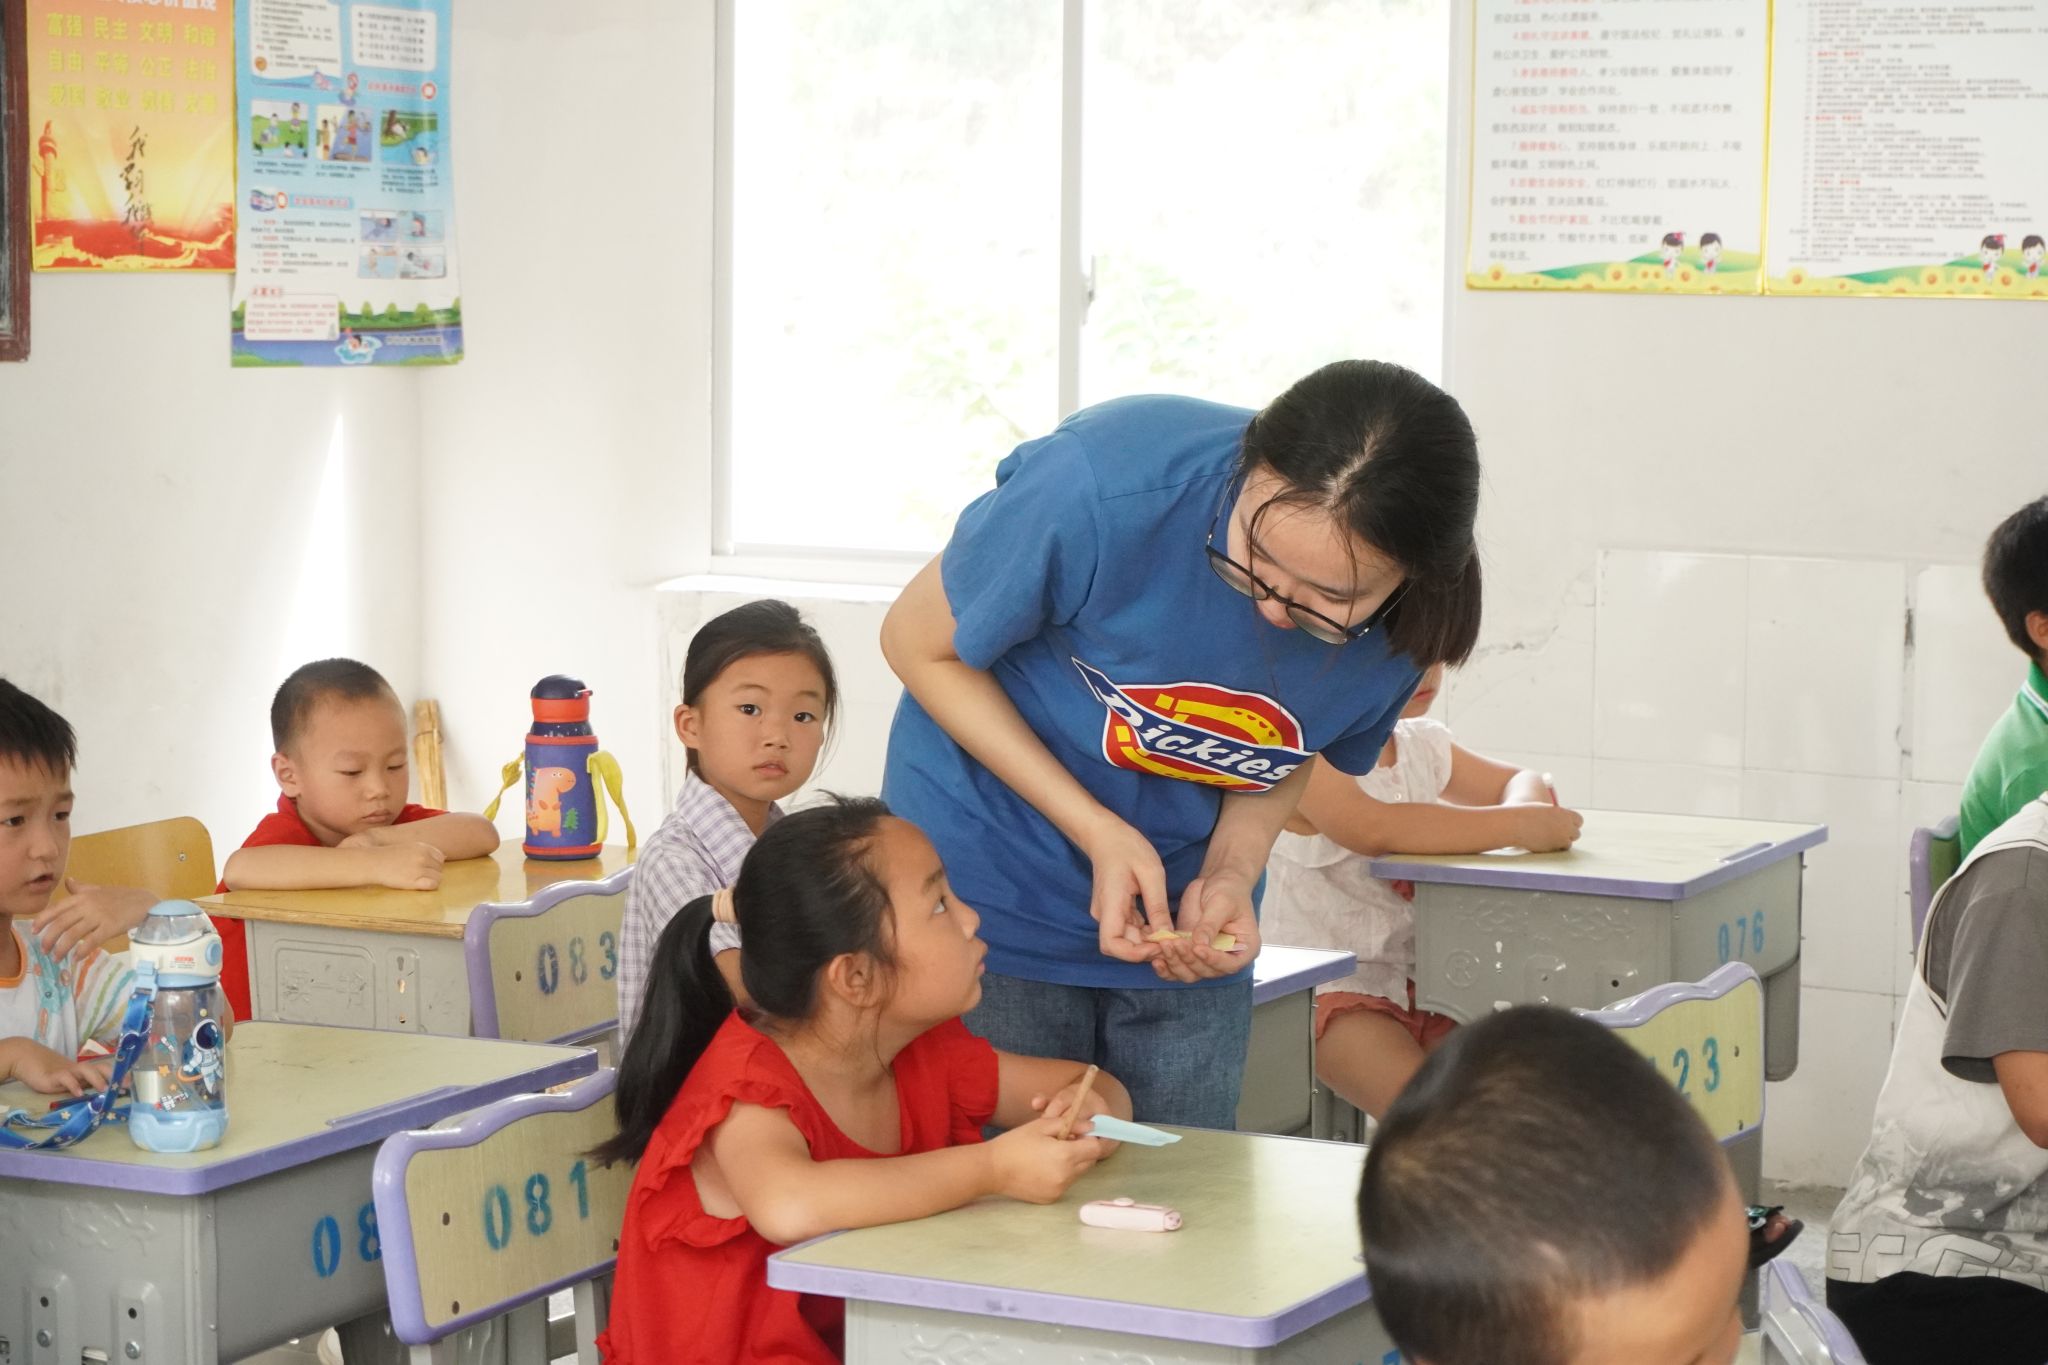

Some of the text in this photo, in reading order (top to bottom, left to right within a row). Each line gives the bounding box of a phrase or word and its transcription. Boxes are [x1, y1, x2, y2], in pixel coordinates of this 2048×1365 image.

[47, 13, 217, 48] 富强 民主 文明 和谐
[49, 48, 217, 81] 自由 平等 公正 法治
[49, 83, 85, 108] 爱国
[1094, 684, 1299, 781] Dickies
[537, 930, 619, 995] 083
[1717, 908, 1765, 964] 076
[482, 1158, 590, 1252] 081
